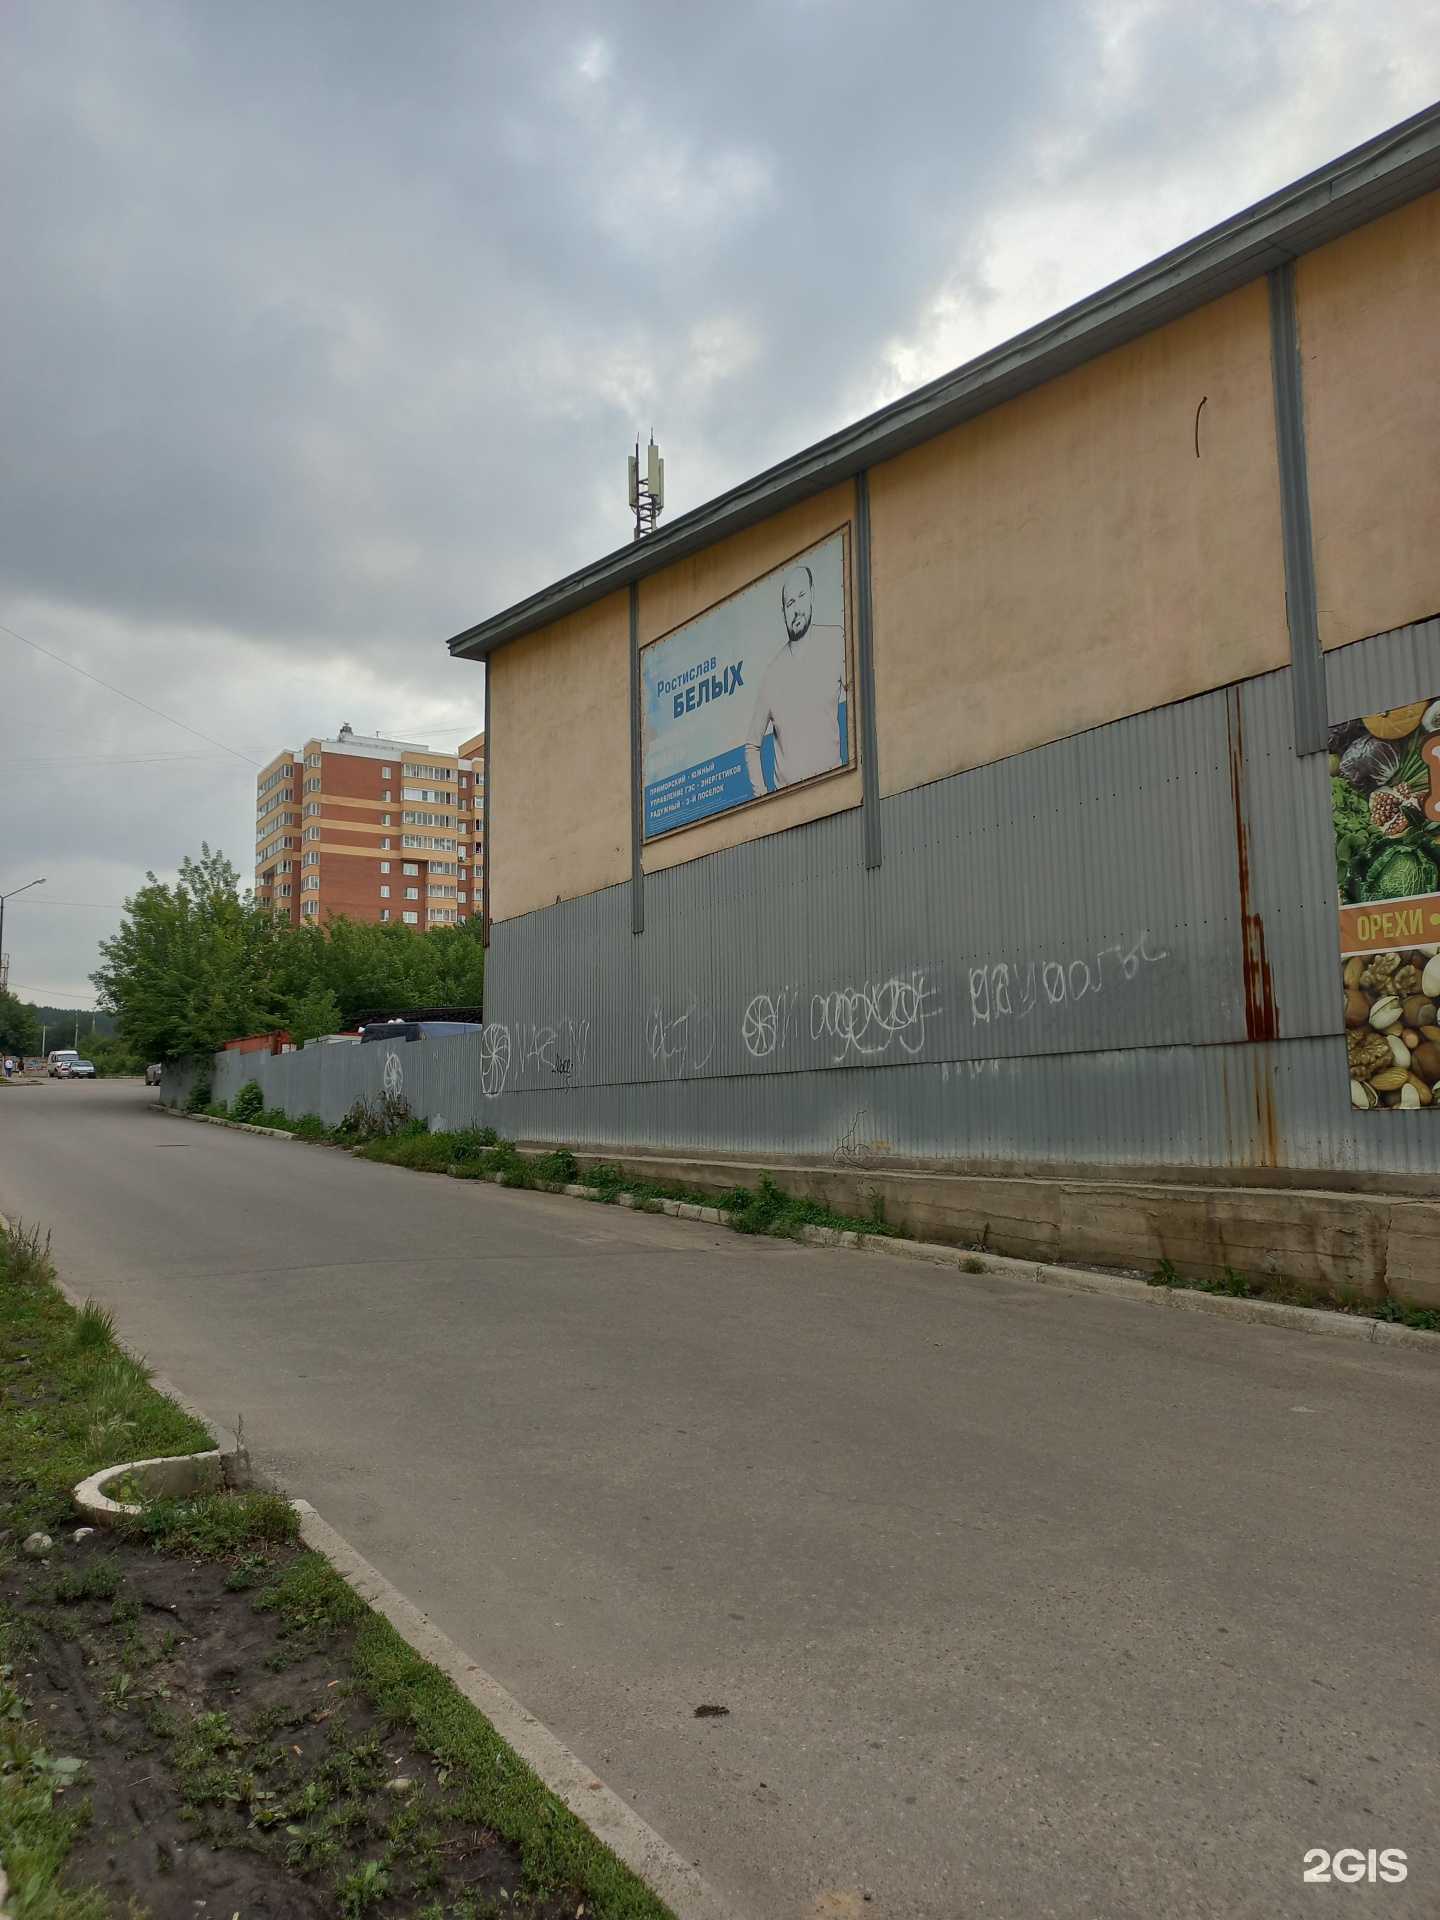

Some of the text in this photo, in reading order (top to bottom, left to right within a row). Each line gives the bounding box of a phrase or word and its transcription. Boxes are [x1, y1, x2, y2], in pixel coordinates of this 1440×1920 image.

[657, 656, 717, 698] Ростислав
[673, 660, 744, 719] БЕЛЫХ
[700, 765, 742, 788] ЭНЕРГЕТИКОВ
[1357, 908, 1424, 942] ОРЕХИ
